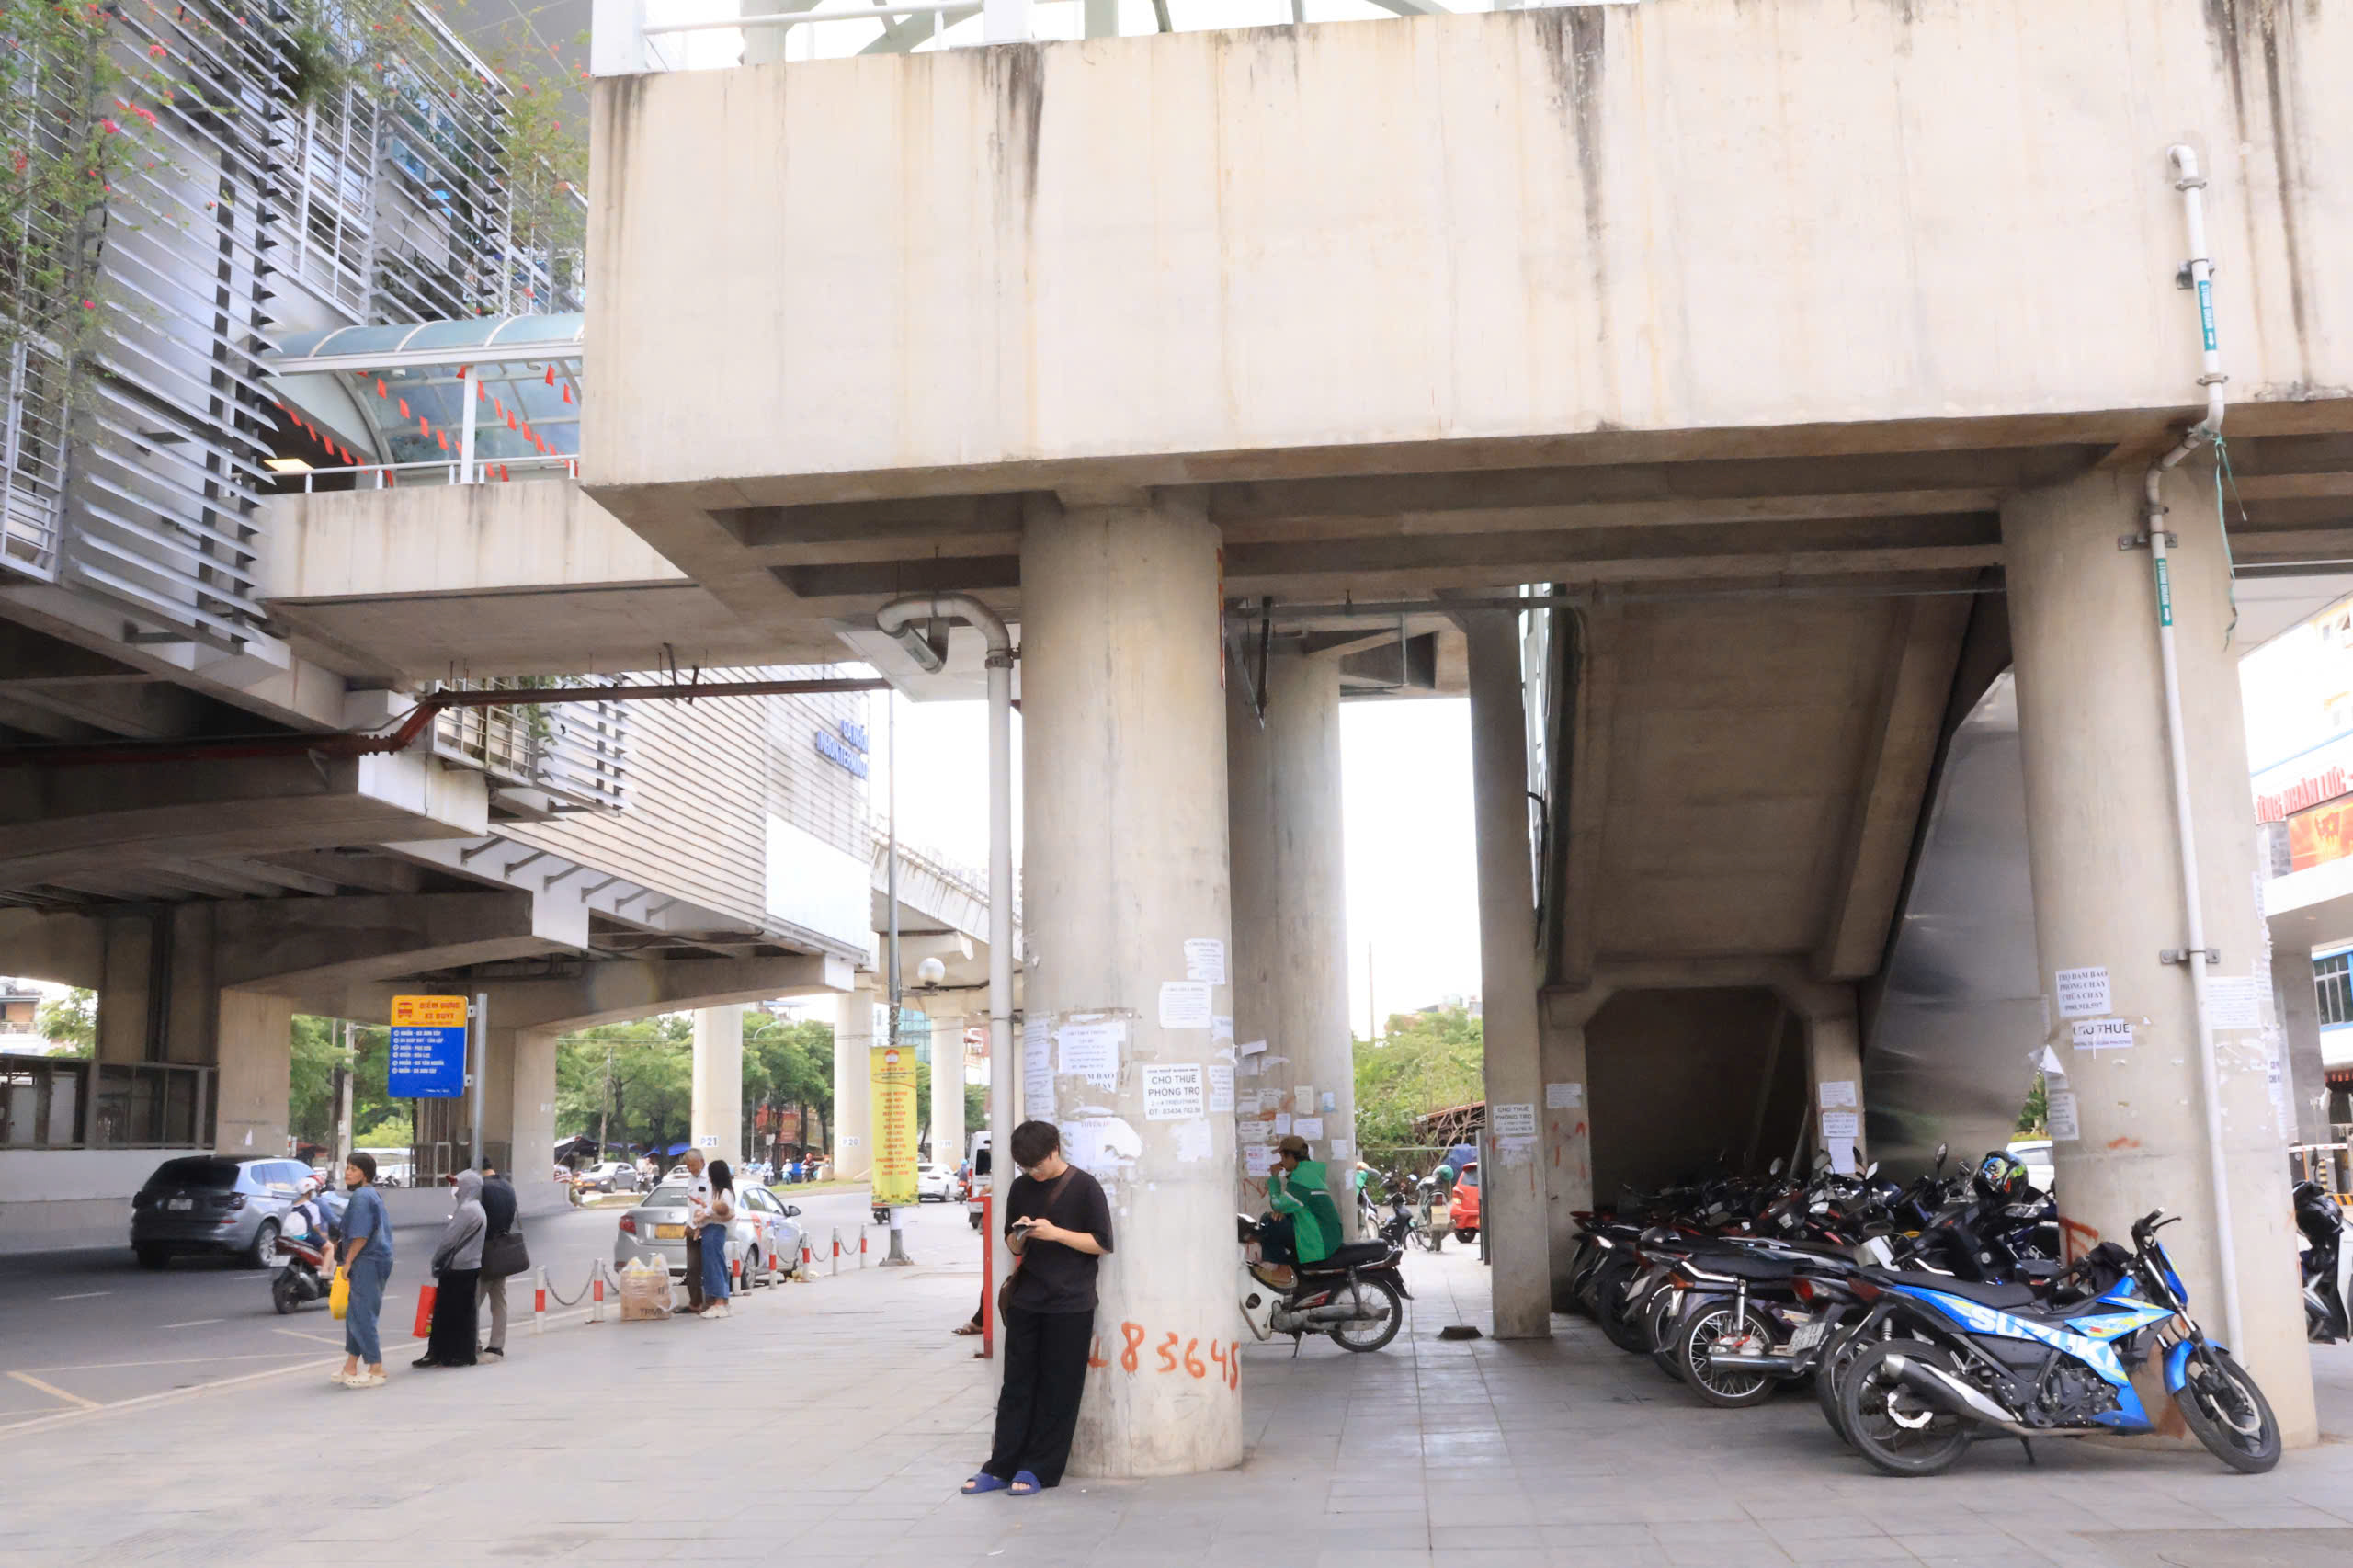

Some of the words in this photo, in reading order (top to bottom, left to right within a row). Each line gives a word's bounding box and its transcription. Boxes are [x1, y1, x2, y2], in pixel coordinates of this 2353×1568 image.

[1152, 1076, 1172, 1085] CHO
[1175, 1074, 1197, 1083] THUÊ
[1183, 1086, 1199, 1096] TRỌ
[701, 1137, 717, 1146] P21
[1969, 1305, 2118, 1369] SUZUKI
